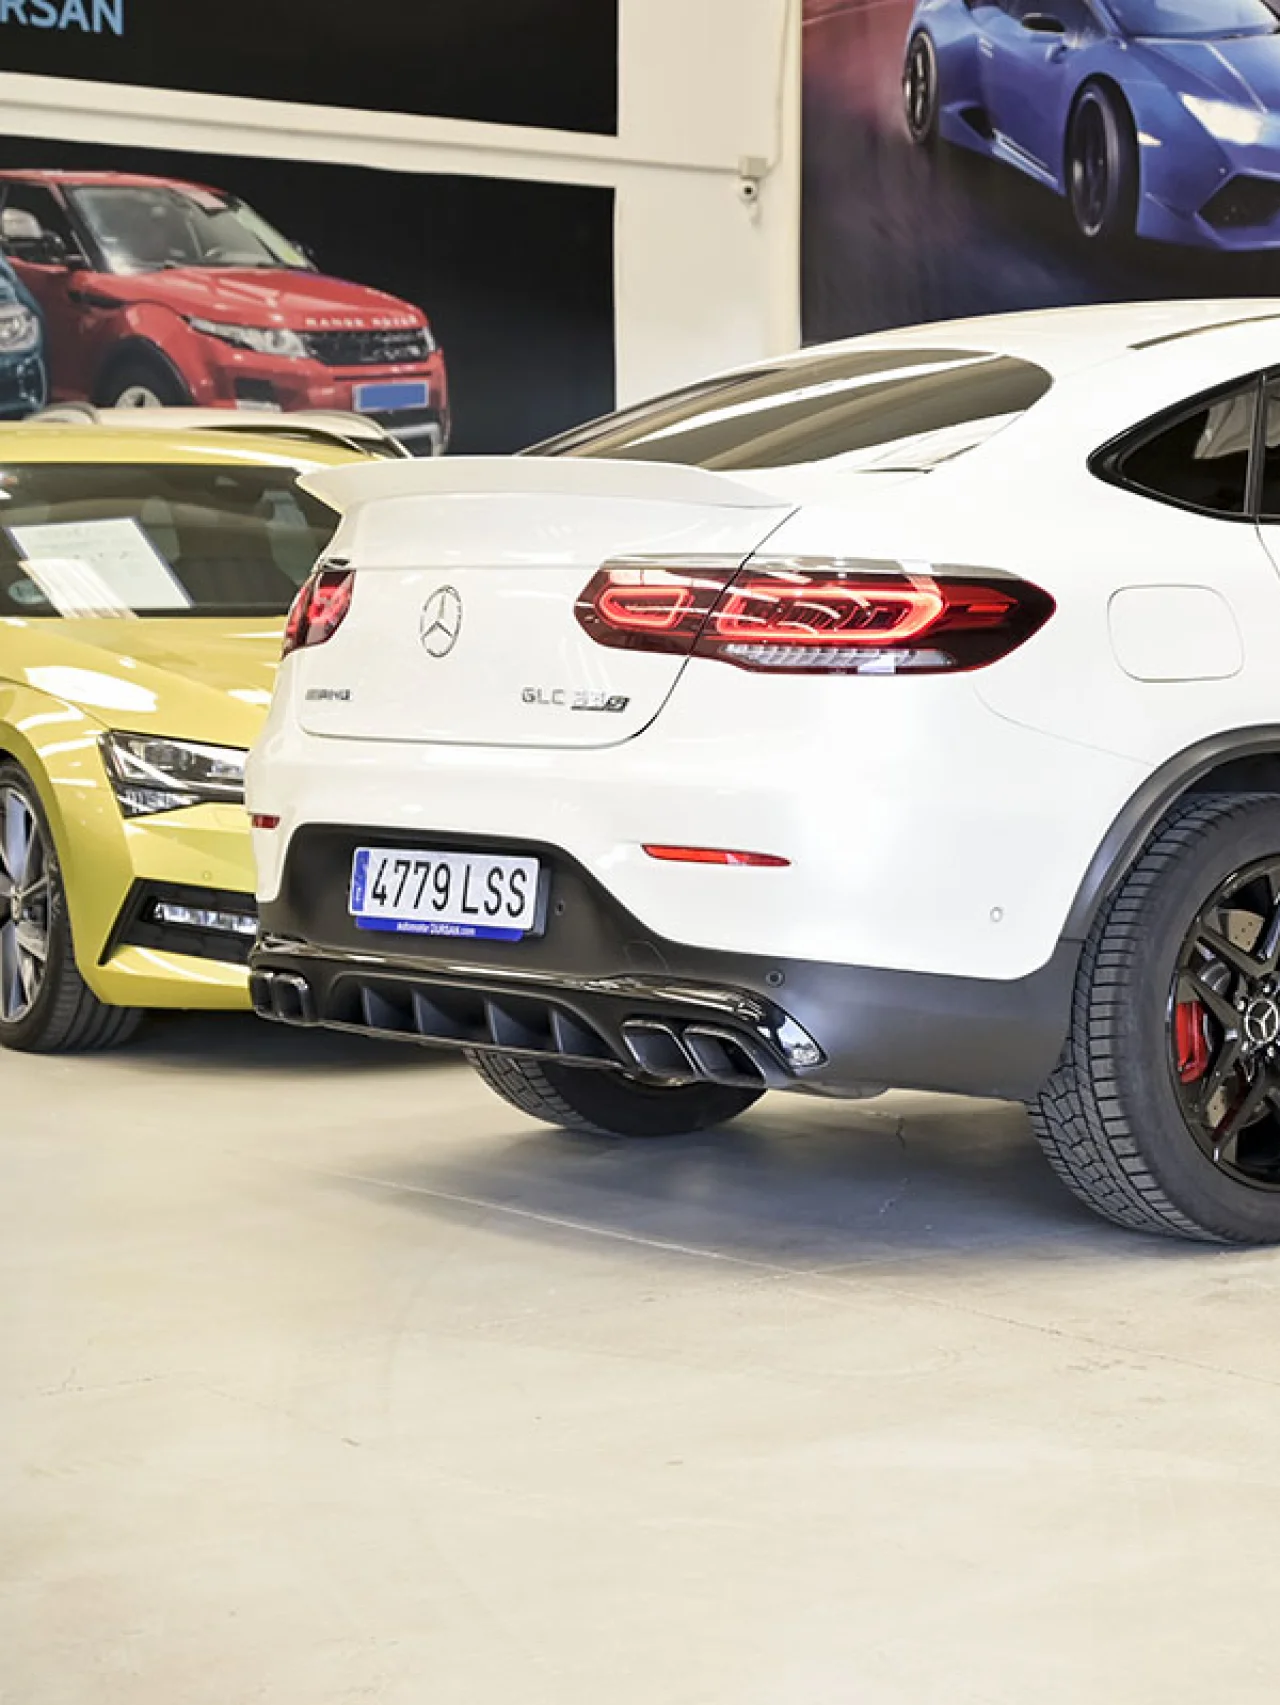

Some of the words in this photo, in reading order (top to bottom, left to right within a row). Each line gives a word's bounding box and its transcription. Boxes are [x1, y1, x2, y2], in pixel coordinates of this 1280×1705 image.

[522, 687, 565, 705] GLC
[371, 858, 450, 911] 4779
[461, 864, 527, 918] LSS
